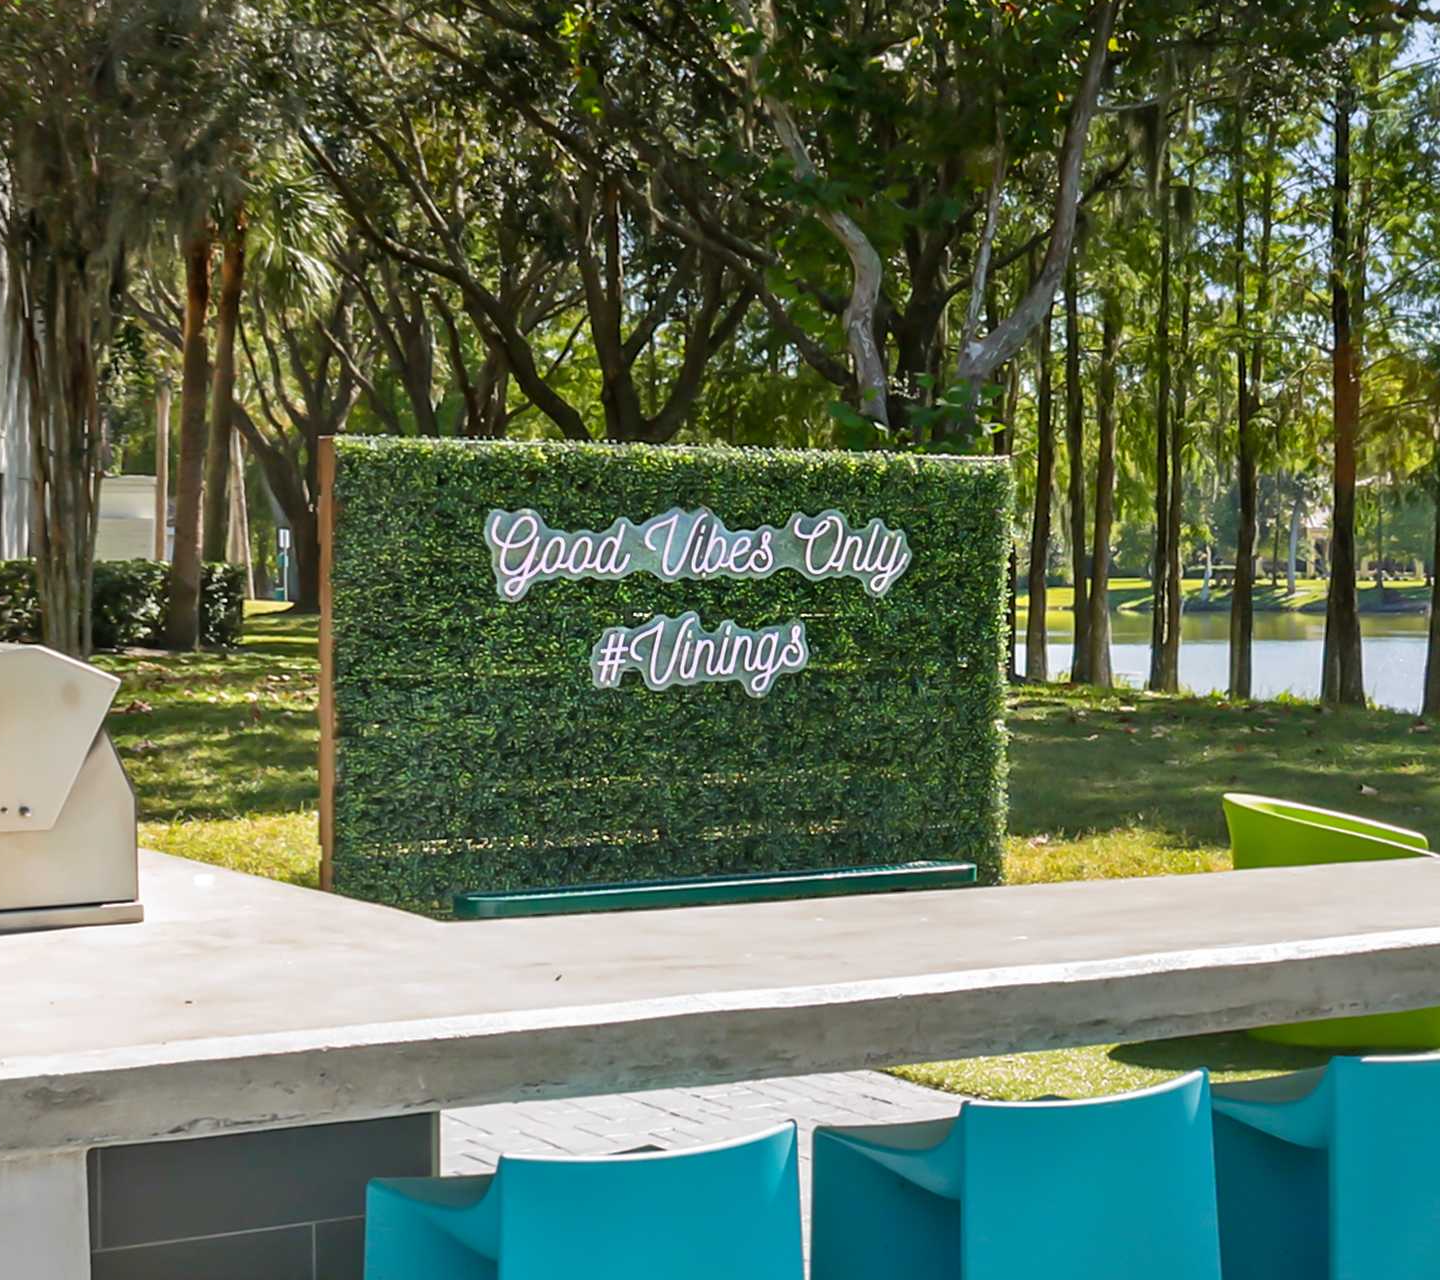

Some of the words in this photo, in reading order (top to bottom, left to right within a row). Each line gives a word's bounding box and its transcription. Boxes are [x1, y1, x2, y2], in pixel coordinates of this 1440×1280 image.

[490, 514, 631, 597] Good
[644, 512, 774, 576] Vibes
[793, 514, 909, 593] Only
[596, 616, 806, 693] #Vinings
